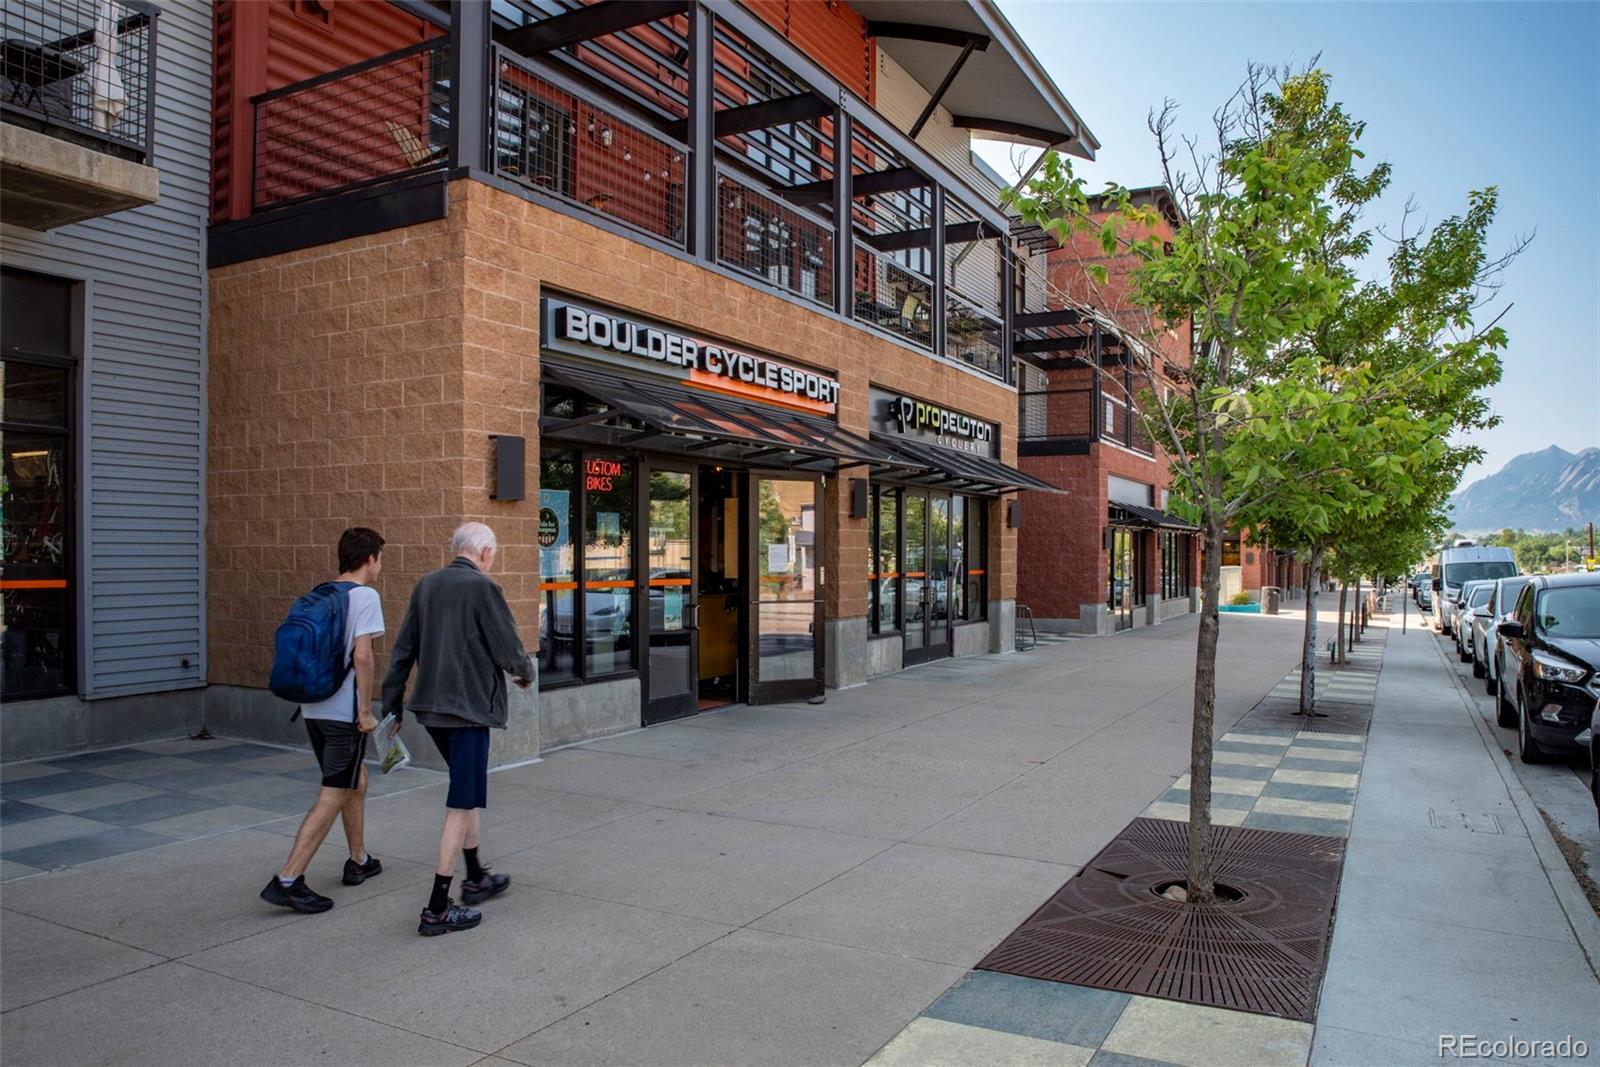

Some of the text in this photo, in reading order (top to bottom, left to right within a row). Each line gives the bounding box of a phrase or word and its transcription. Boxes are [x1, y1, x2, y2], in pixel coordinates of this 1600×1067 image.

[566, 306, 840, 404] BOULDER CYCLESPORT
[585, 459, 621, 476] USTOM
[586, 475, 613, 491] BIKES
